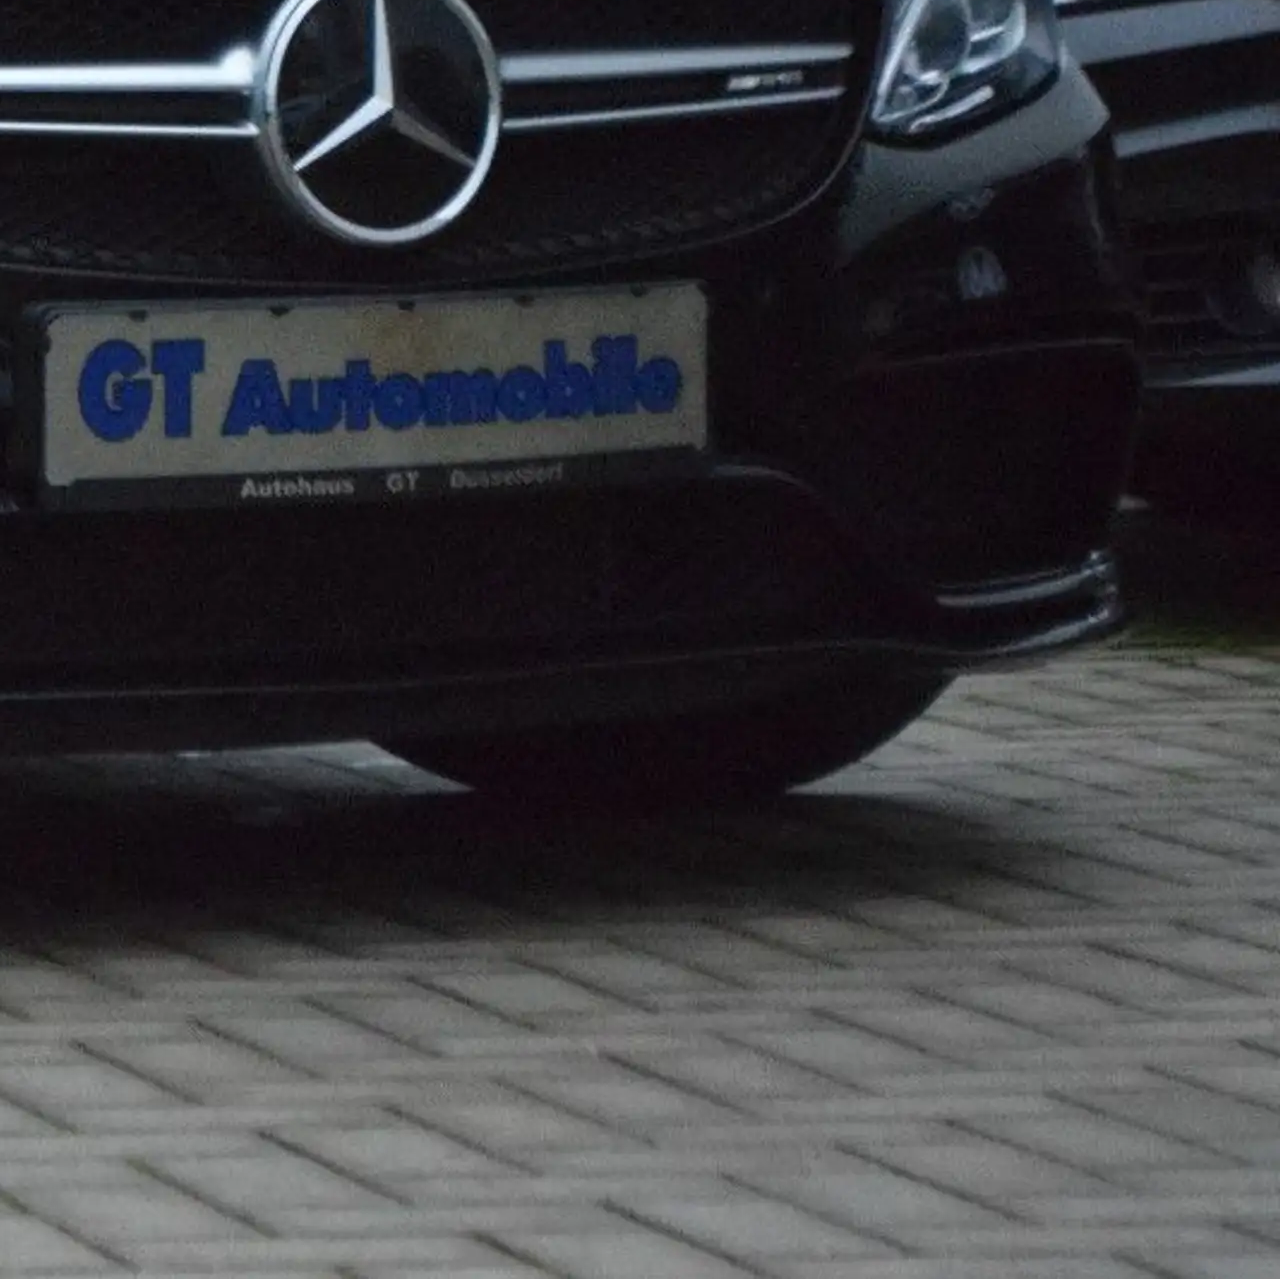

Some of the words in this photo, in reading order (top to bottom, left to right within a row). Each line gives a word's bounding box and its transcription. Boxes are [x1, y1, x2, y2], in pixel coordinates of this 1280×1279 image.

[78, 338, 206, 443] GT
[222, 334, 683, 437] Automobile
[240, 475, 355, 499] Autohaus
[386, 469, 421, 495] GT
